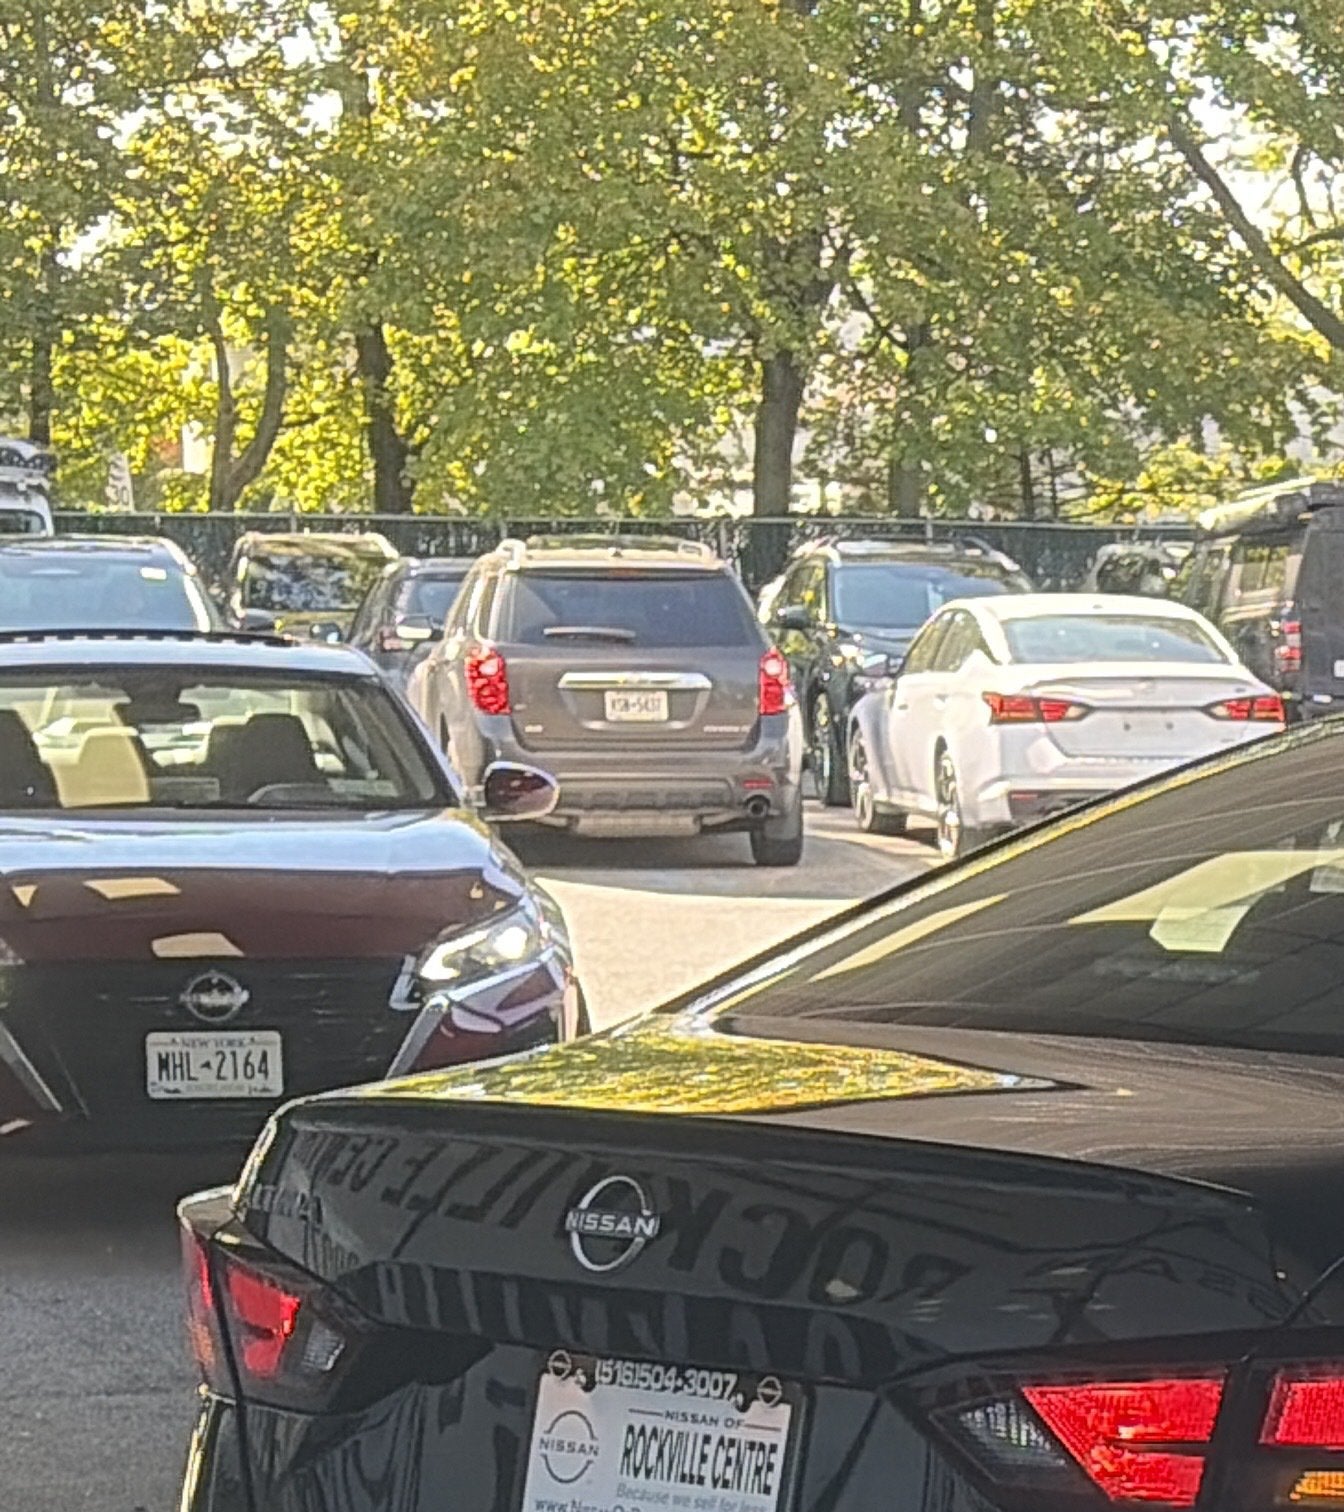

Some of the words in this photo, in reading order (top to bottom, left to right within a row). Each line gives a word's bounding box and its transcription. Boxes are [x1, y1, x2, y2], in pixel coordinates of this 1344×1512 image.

[565, 1210, 656, 1238] NISSAN
[664, 1410, 719, 1427] NISSAN
[724, 1417, 745, 1429] OF
[540, 1437, 599, 1456] NISSAN
[620, 1424, 712, 1486] ROCKVILLE
[711, 1435, 778, 1496] CENTRE
